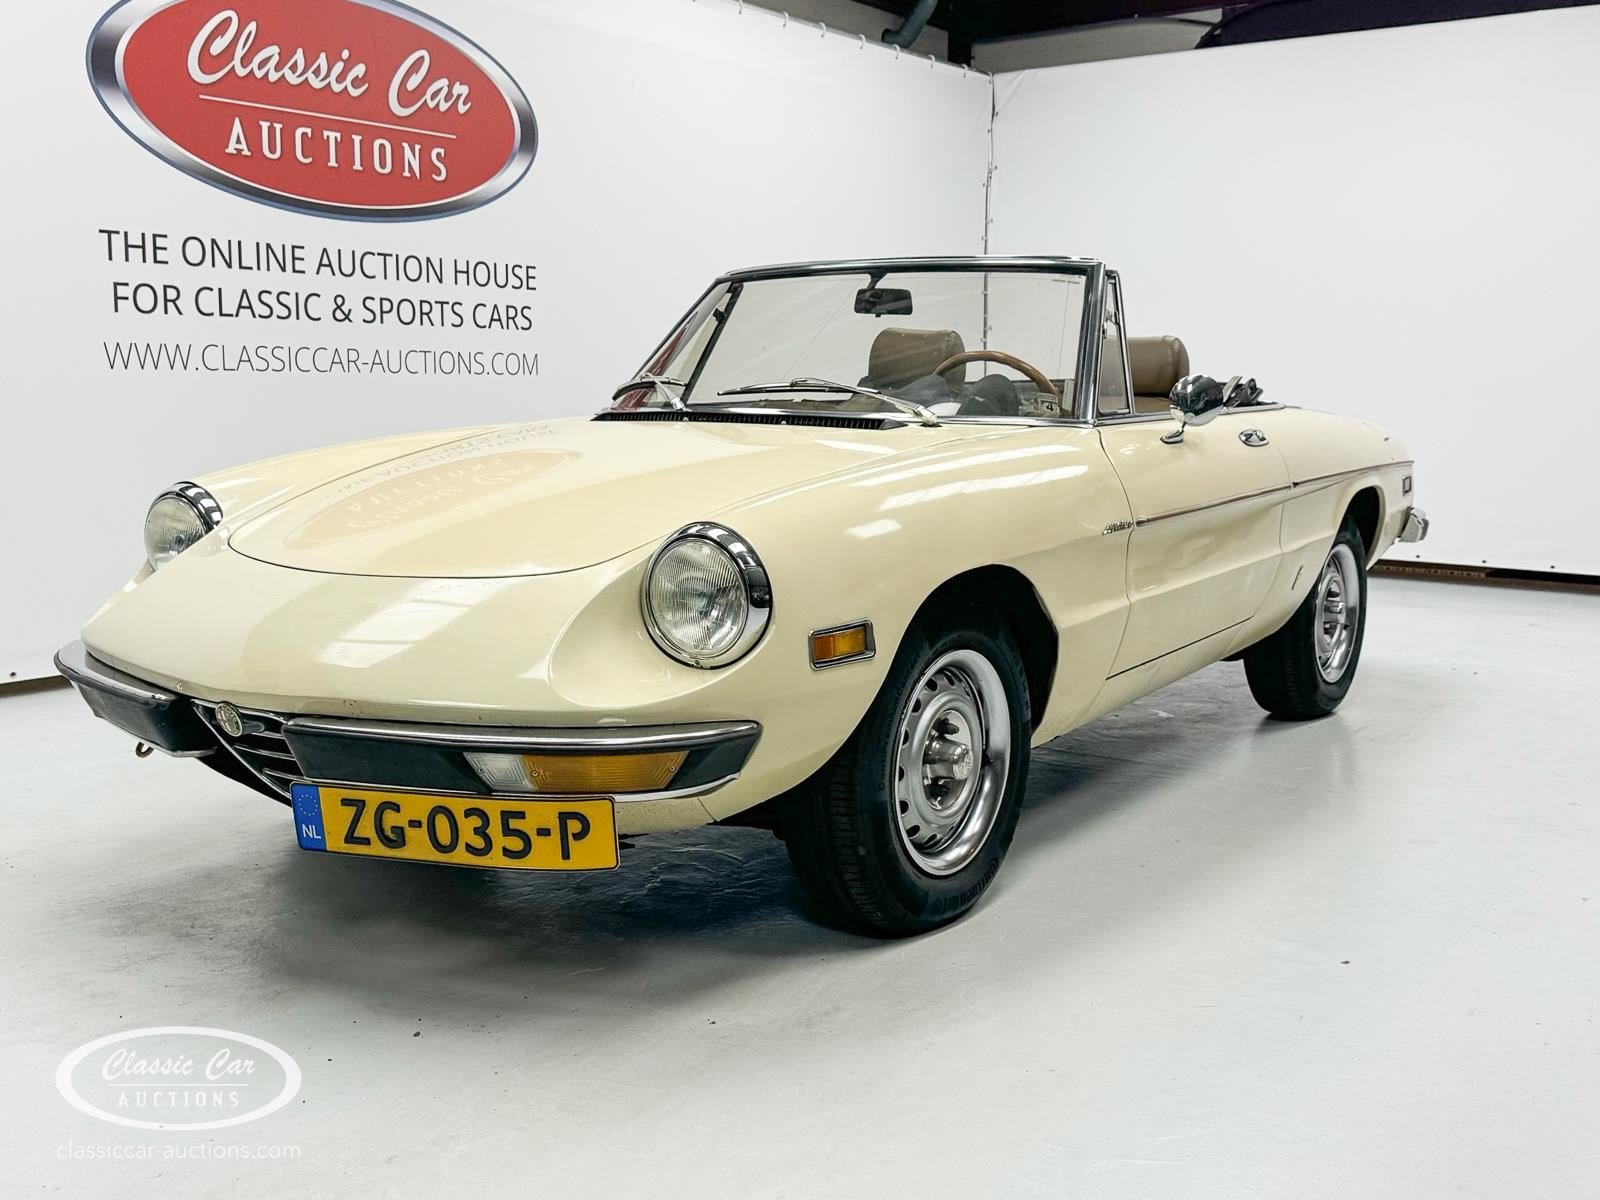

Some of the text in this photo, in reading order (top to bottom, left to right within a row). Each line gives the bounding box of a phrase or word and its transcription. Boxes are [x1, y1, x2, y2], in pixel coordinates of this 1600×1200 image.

[187, 9, 472, 117] Classic Car
[225, 117, 448, 182] AUCTIONS
[99, 229, 537, 291] THE ONLINE AUCTION HOUSE
[112, 281, 533, 331] FOR CLASSIC & SPORTS CARS
[103, 341, 539, 376] WWW.CLASSICCAR-AUCTIONS.COM
[302, 823, 322, 839] NL
[340, 798, 590, 861] ZG-035-P
